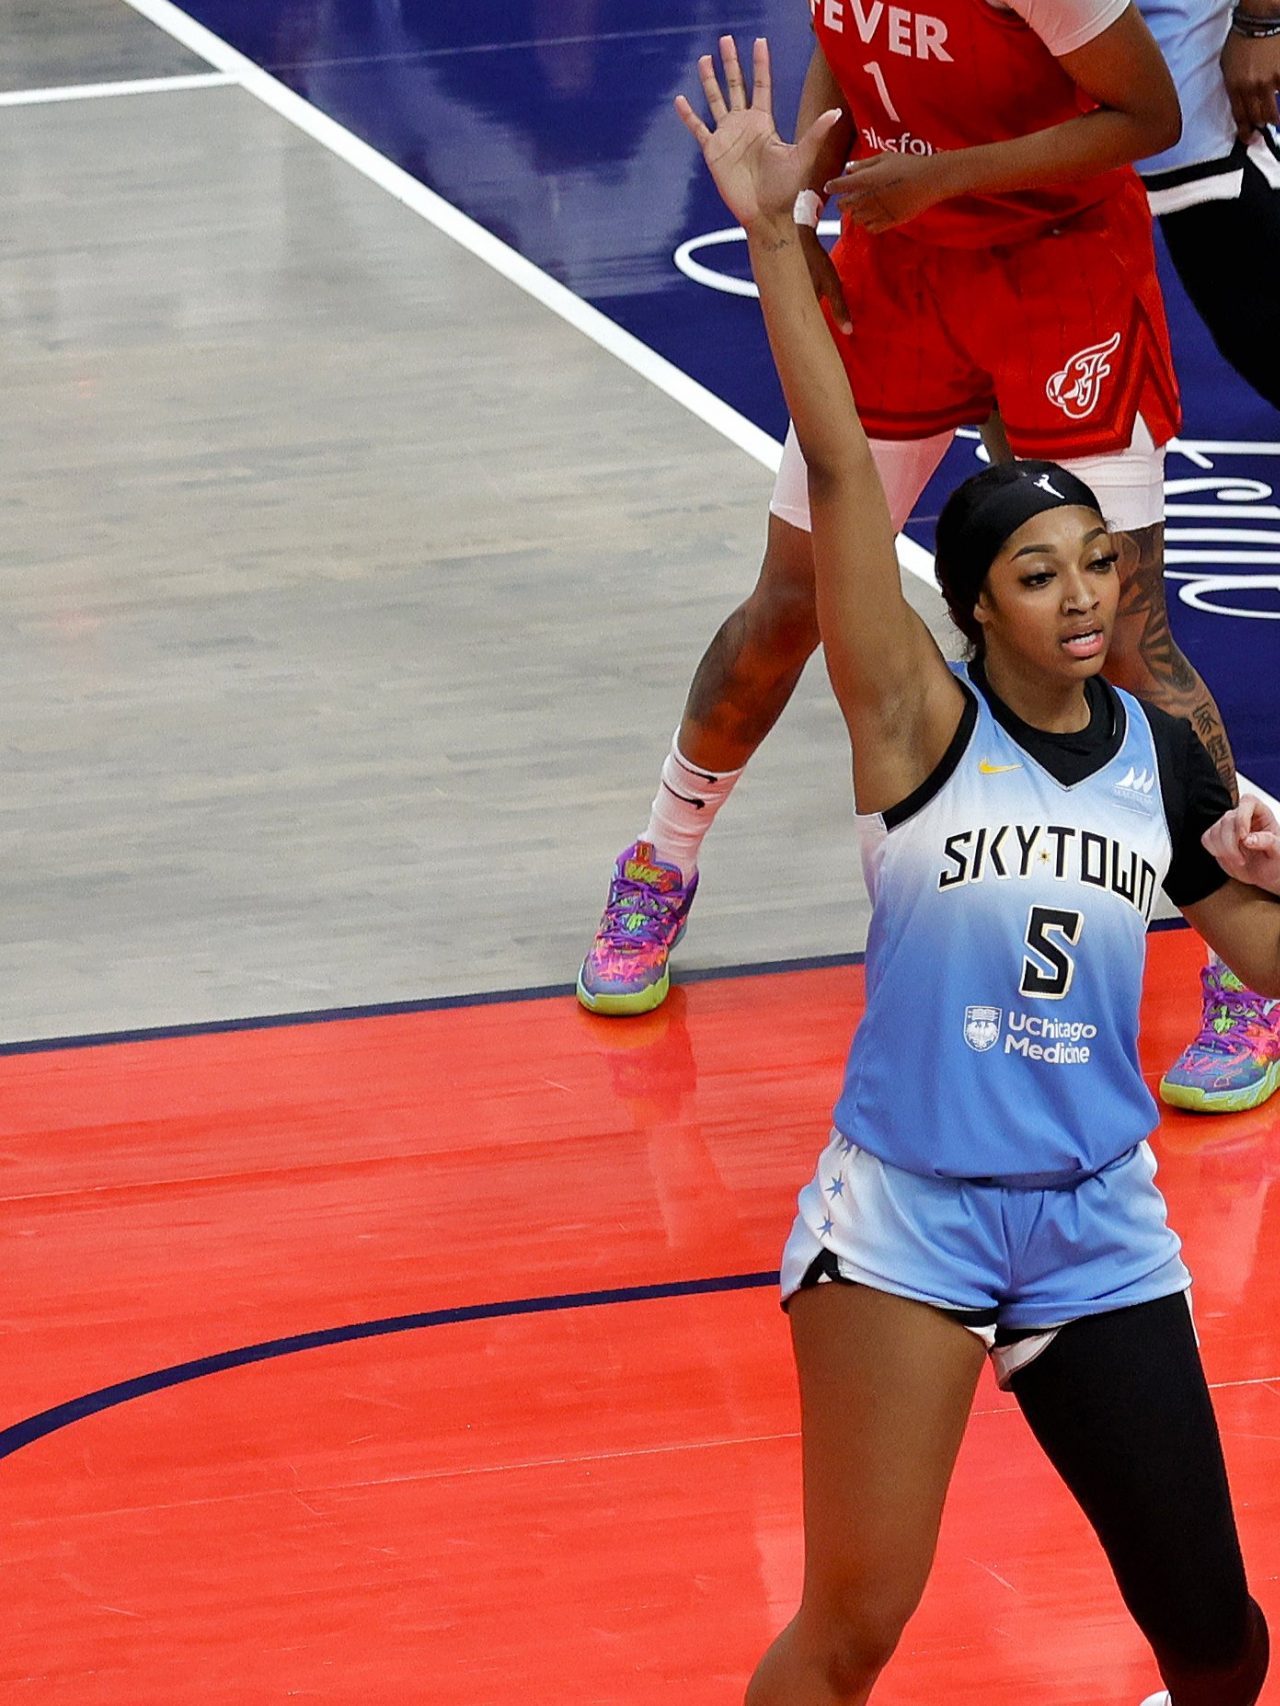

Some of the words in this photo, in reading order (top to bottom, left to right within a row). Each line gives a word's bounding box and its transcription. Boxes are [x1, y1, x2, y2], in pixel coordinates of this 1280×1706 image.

[811, 0, 955, 62] EVER
[863, 61, 900, 122] 1
[1018, 904, 1085, 1000] 5
[1004, 1034, 1090, 1064] Medicine
[1008, 1011, 1097, 1039] UChicago
